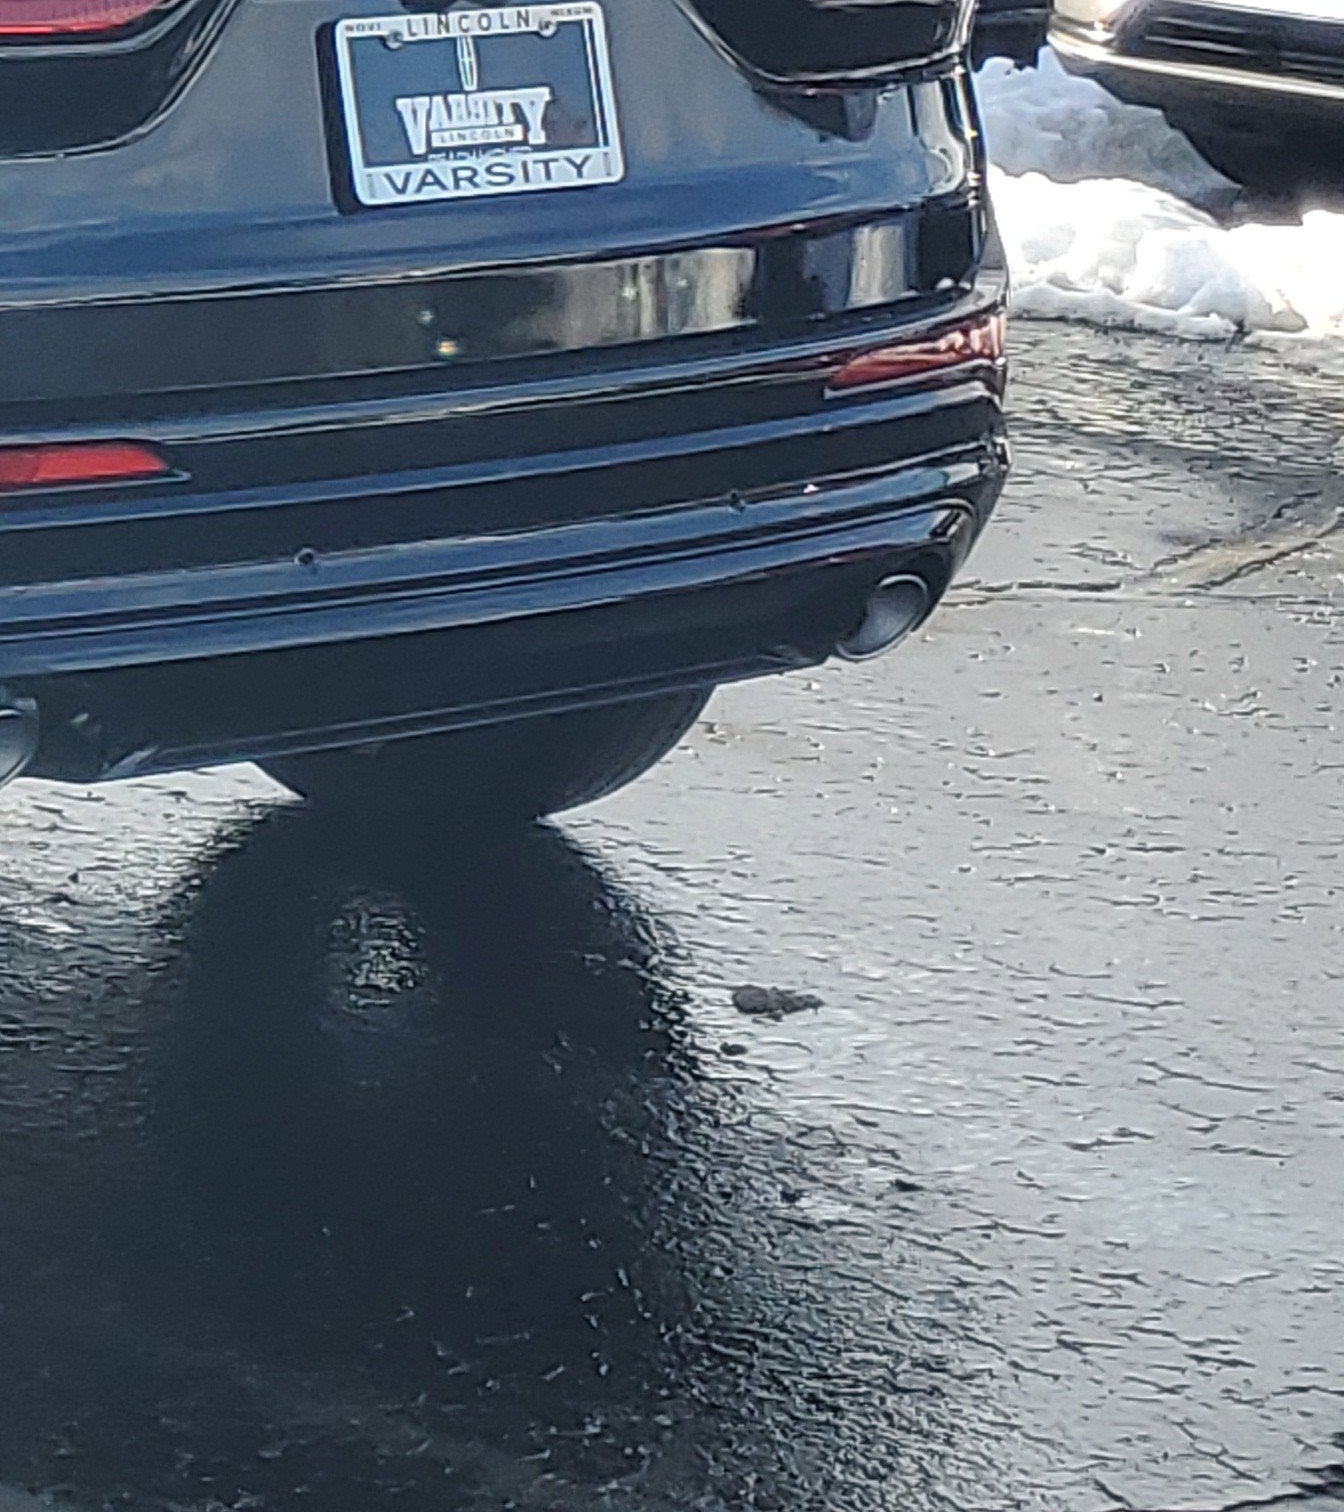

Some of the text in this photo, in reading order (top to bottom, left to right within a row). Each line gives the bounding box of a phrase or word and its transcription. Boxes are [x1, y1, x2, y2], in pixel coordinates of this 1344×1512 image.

[406, 8, 531, 37] LINCOLN
[395, 86, 551, 155] VARSITY
[440, 128, 515, 144] LINCOLN
[383, 154, 592, 195] VARSITY
